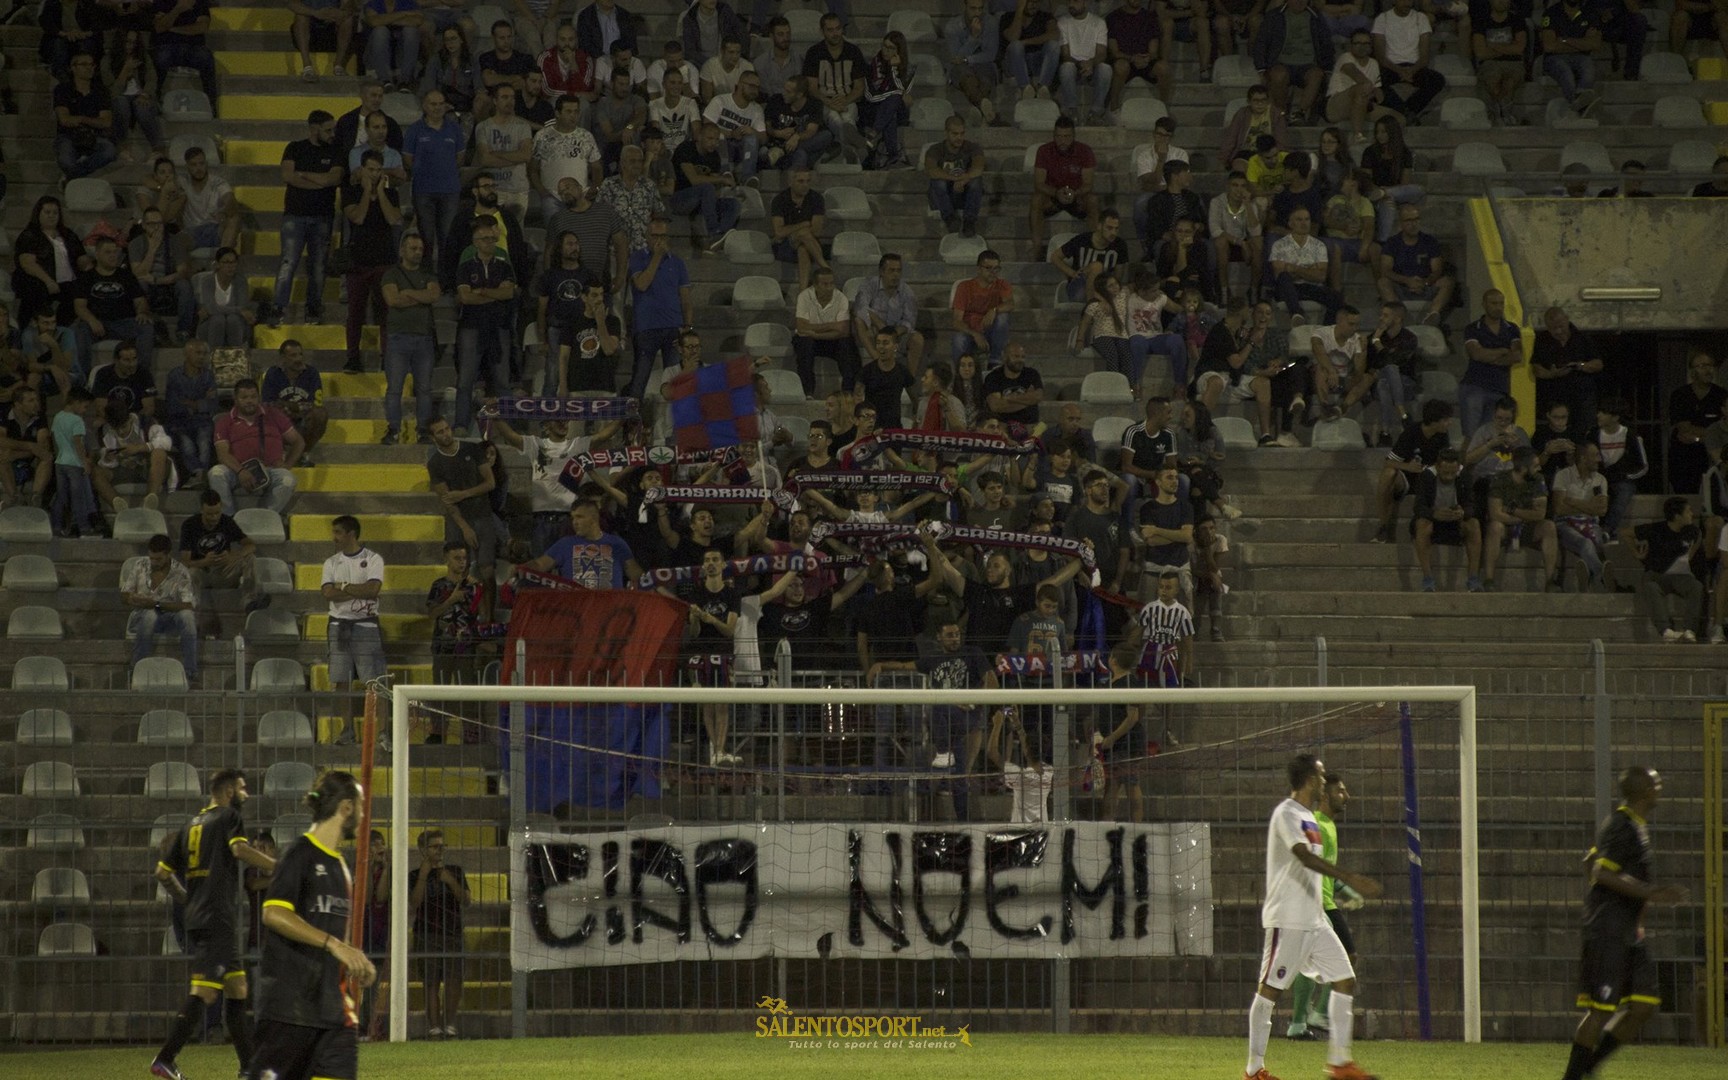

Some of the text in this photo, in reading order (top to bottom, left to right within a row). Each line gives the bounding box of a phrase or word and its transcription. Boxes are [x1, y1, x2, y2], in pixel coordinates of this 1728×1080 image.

[515, 399, 611, 413] CUSP
[915, 475, 939, 484] 1927
[667, 486, 772, 499] CASARANO
[955, 527, 1079, 549] CASARANO
[187, 824, 203, 869] 9
